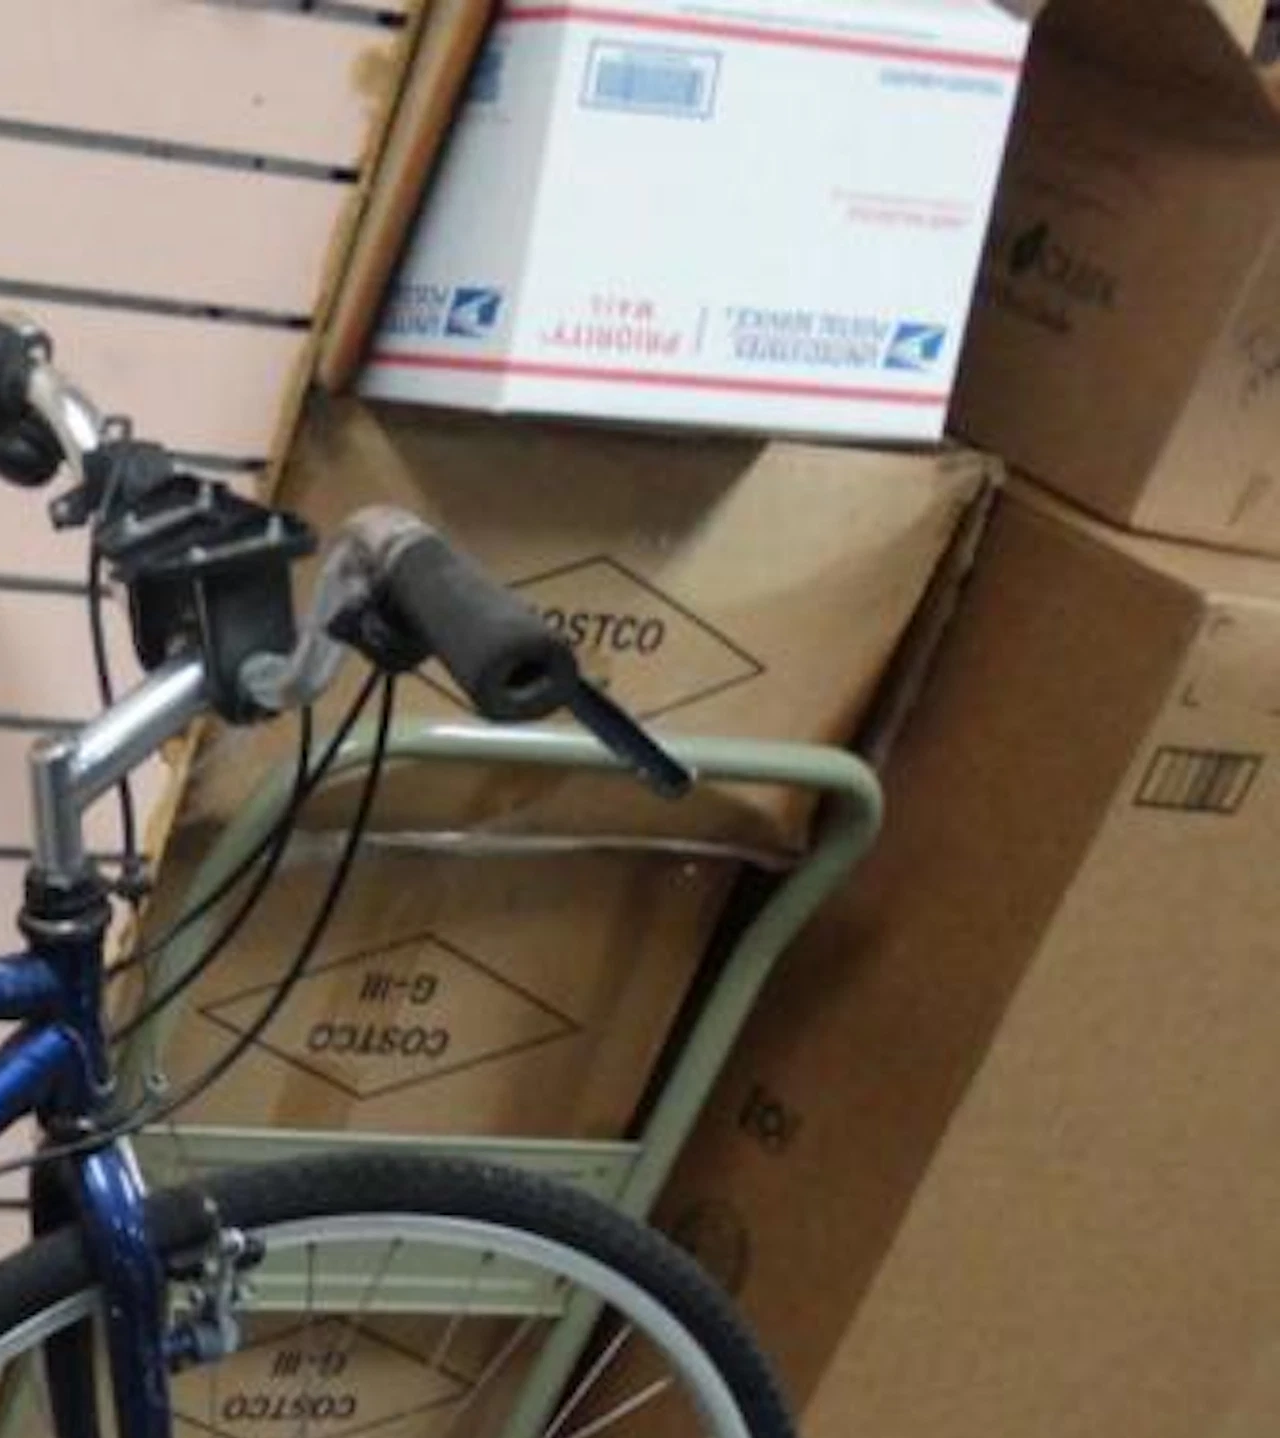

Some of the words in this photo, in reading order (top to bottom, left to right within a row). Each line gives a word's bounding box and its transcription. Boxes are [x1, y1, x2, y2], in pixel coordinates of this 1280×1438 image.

[540, 607, 665, 656] OSTCO
[307, 1022, 450, 1059] COSTCO
[223, 1394, 357, 1421] COSTCO
